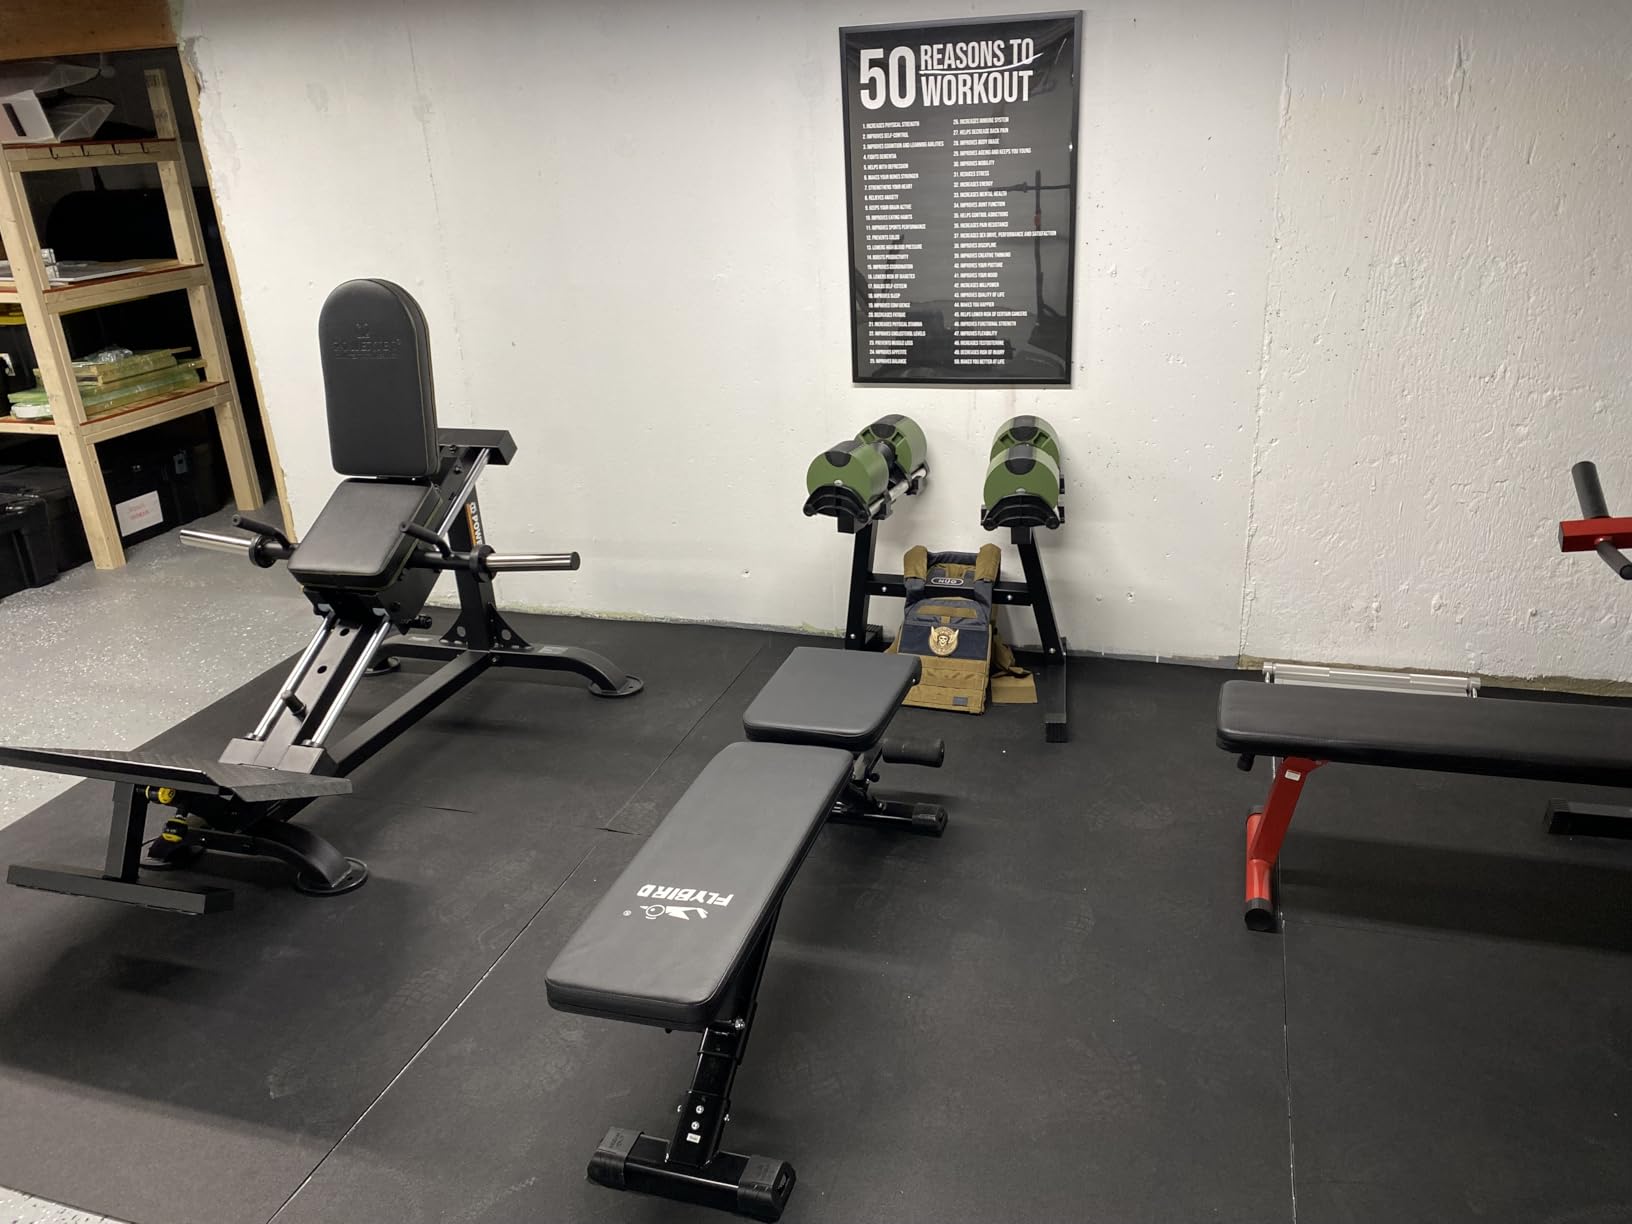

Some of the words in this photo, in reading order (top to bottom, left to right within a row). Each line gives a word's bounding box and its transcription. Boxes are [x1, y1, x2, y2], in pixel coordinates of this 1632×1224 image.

[920, 40, 1005, 71] REASONS
[1010, 38, 1034, 66] TO
[860, 46, 916, 110] 50
[920, 70, 1034, 106] WORKOUT
[636, 884, 734, 906] FLYBIRD
